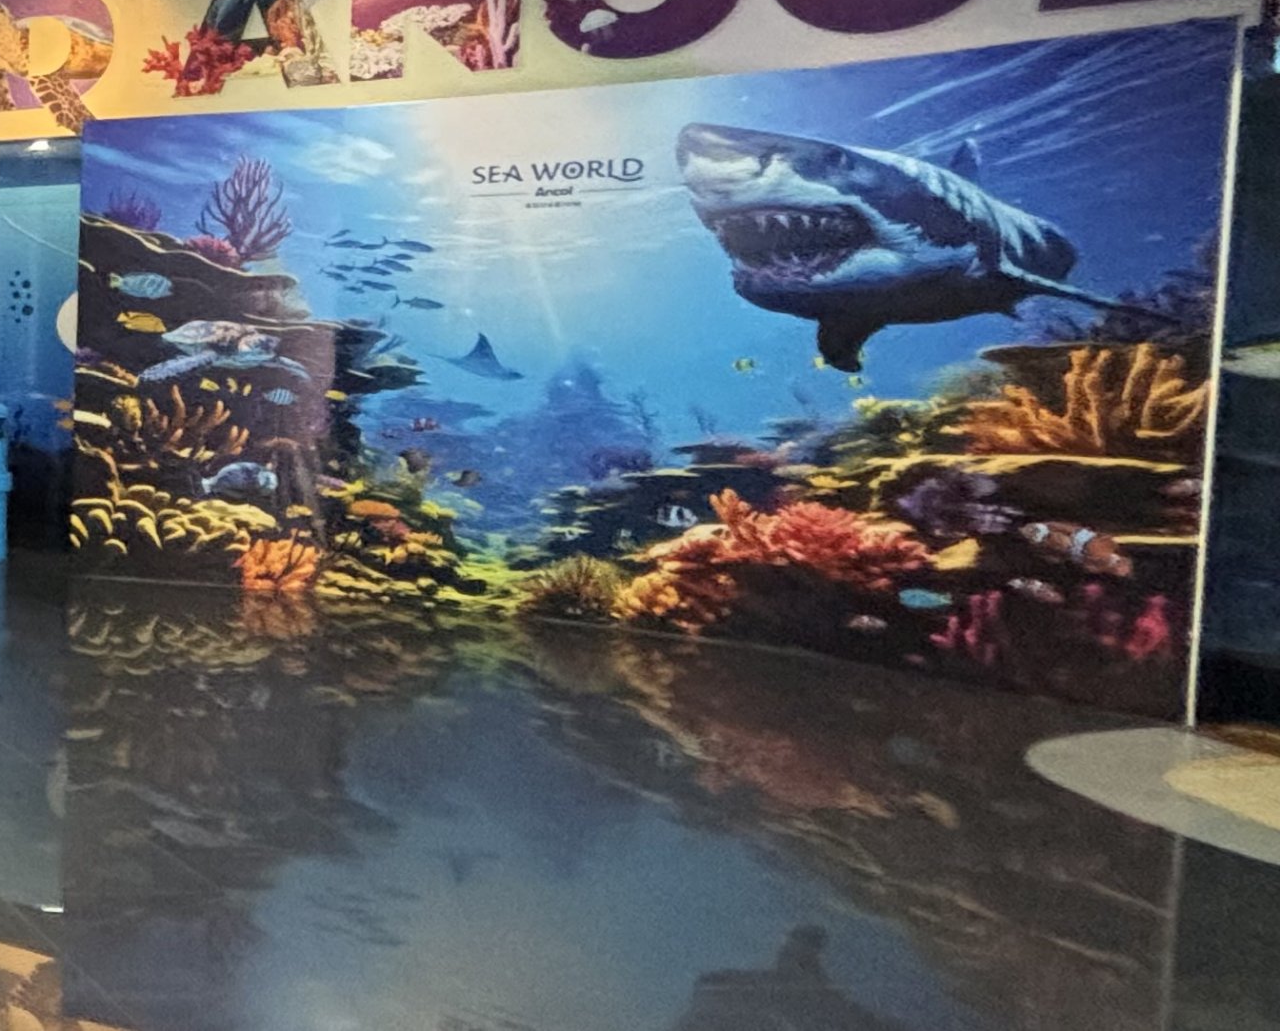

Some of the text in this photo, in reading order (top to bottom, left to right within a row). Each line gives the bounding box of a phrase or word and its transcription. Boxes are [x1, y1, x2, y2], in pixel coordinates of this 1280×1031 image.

[472, 157, 644, 184] SEA WORLD
[534, 186, 574, 197] Ancol
